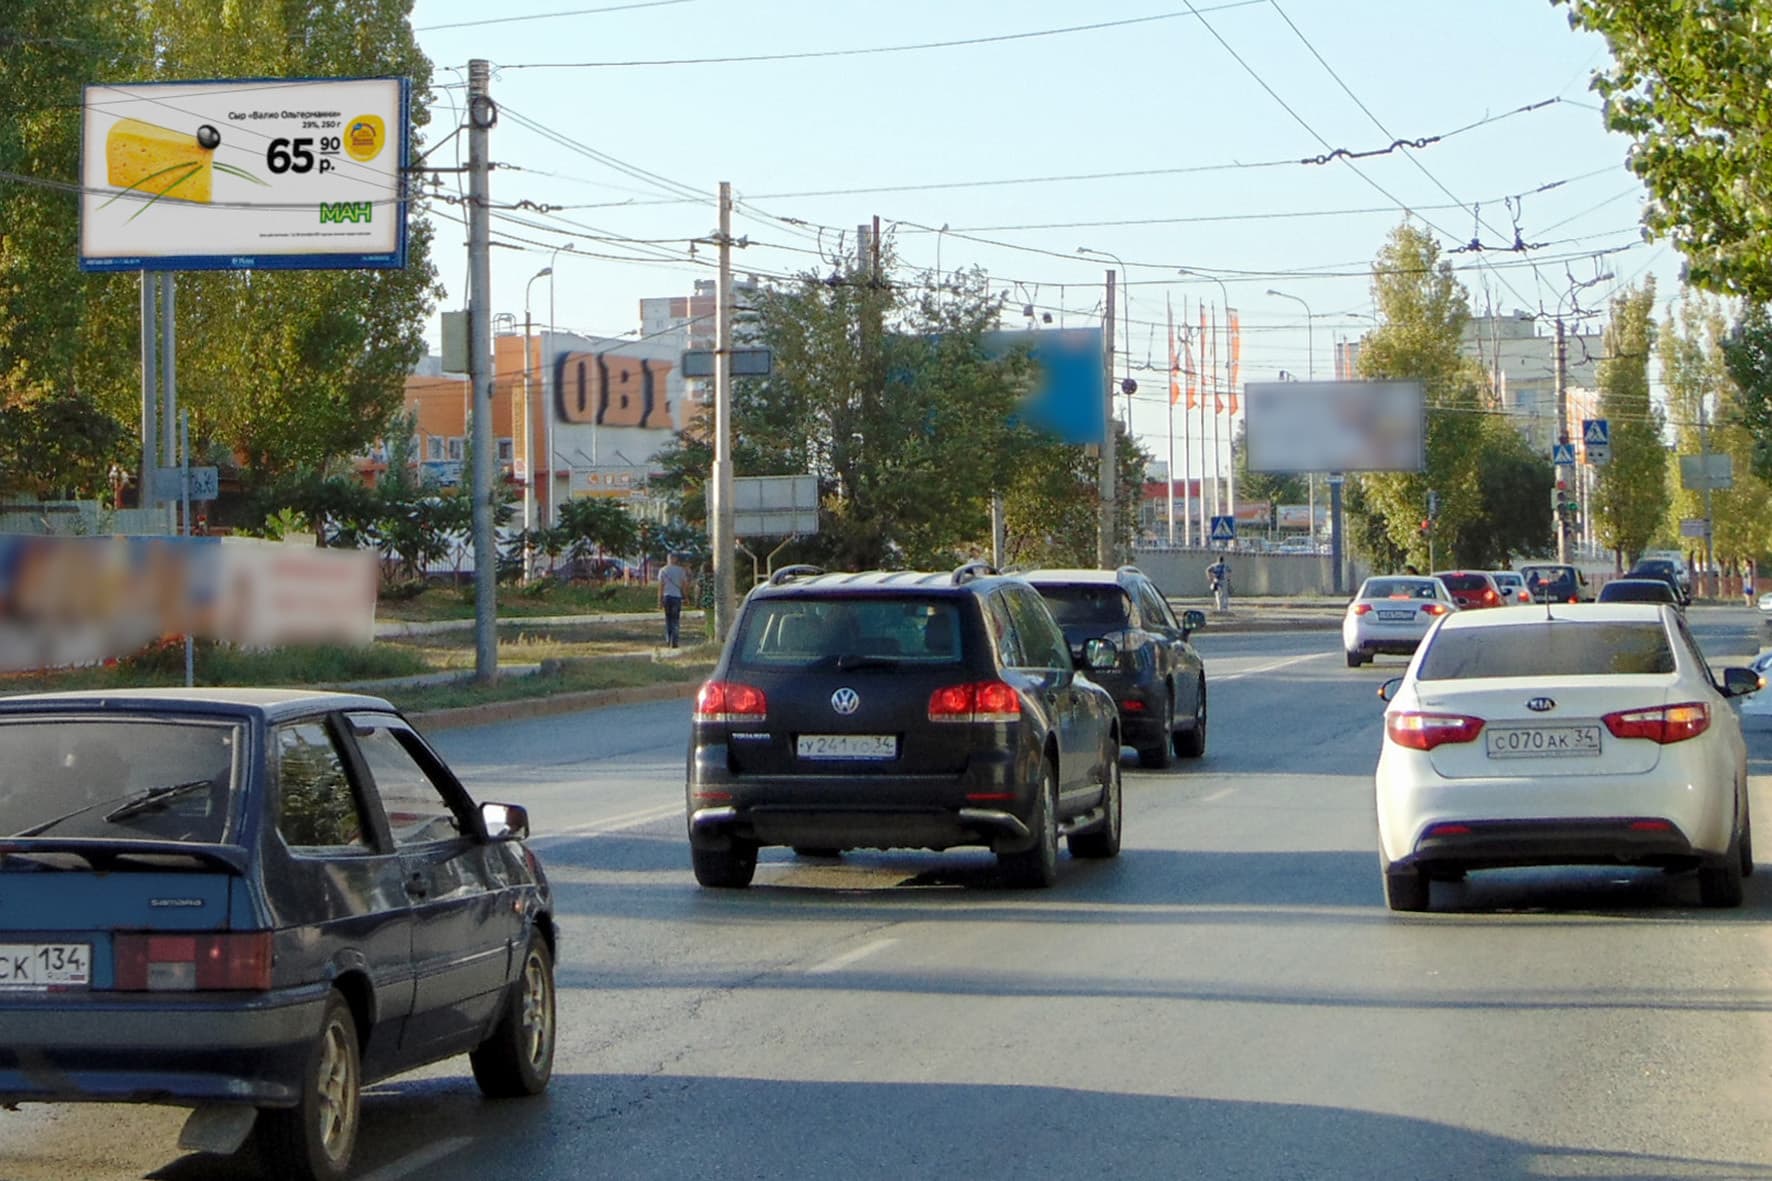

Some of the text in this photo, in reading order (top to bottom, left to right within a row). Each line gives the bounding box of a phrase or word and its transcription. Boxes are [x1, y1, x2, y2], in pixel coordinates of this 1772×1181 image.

[228, 112, 246, 120] Сыр
[267, 138, 314, 174] 65
[320, 136, 341, 150] 90
[319, 158, 335, 173] р.
[320, 201, 372, 223] МАН
[554, 351, 674, 430] OBI
[1530, 699, 1552, 709] KIA
[1575, 729, 1593, 742] 34
[38, 947, 81, 971] 134
